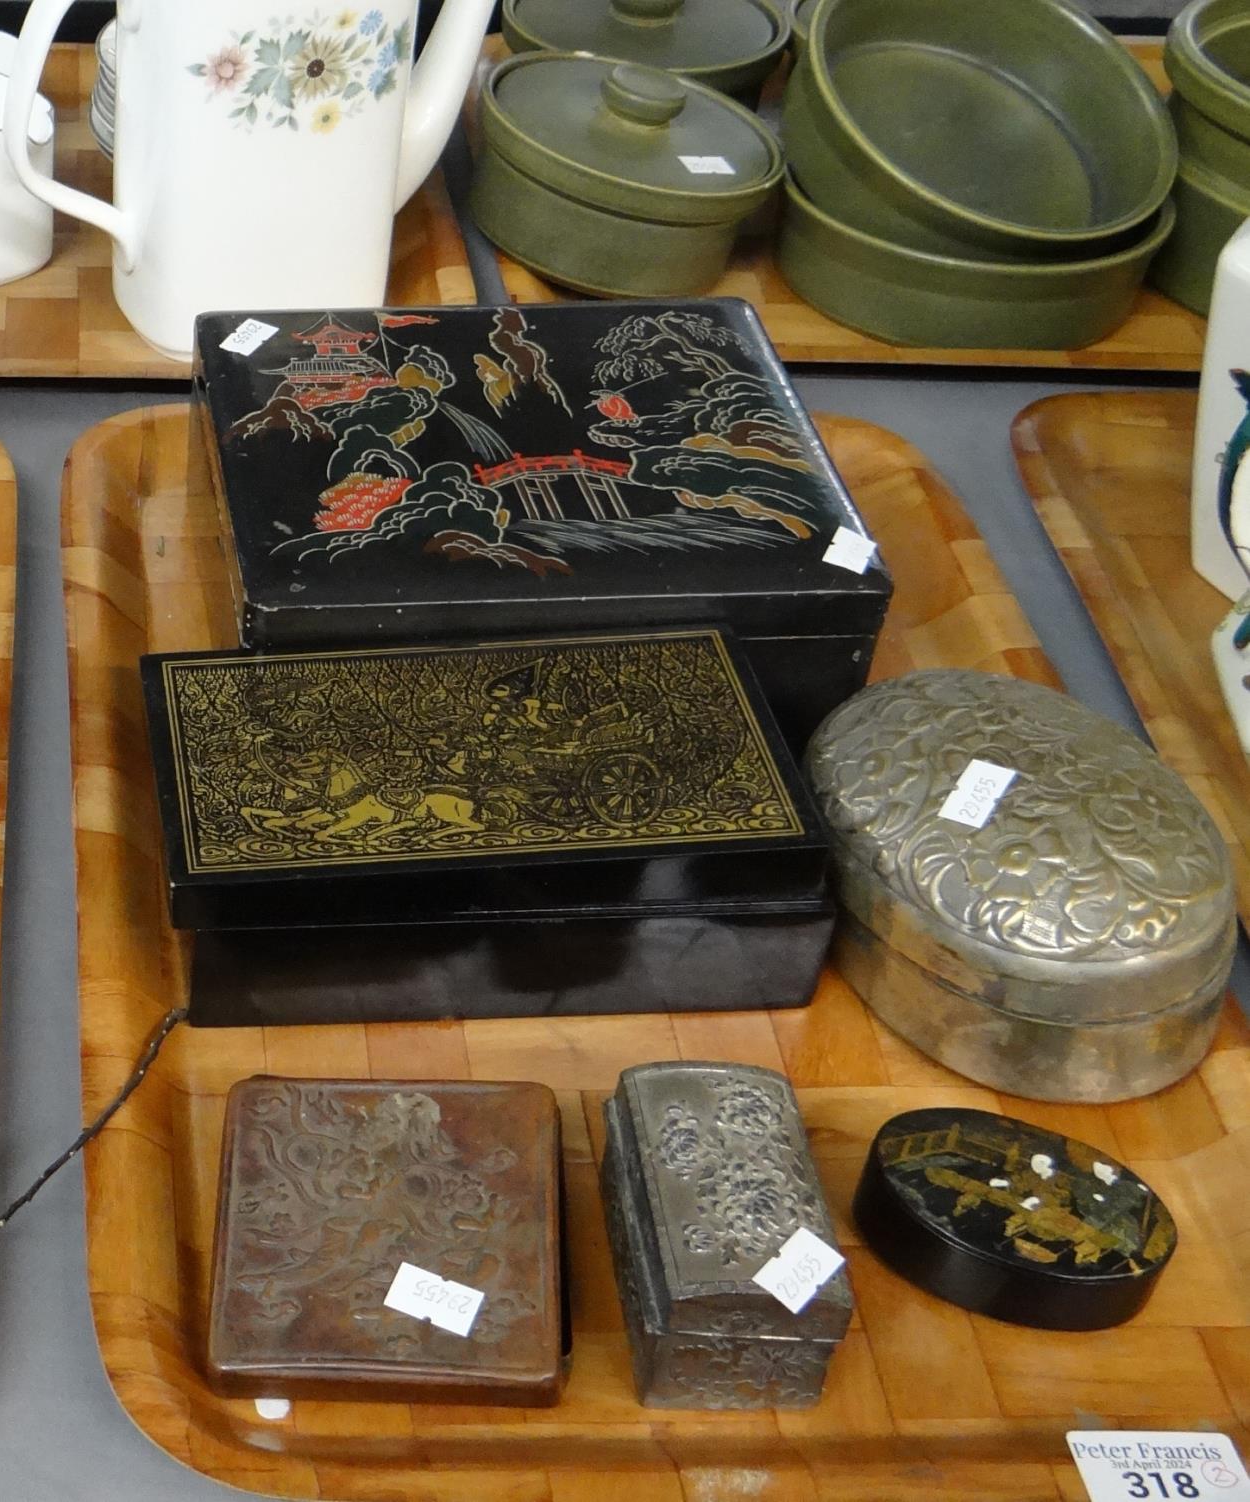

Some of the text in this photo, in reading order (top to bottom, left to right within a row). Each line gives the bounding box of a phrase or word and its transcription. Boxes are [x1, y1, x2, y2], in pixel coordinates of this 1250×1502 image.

[958, 776, 997, 820] 29455
[412, 1279, 474, 1314] 29455
[1072, 1442, 1222, 1461] Peter Francis
[1111, 1460, 1193, 1470] 3rd April 2024
[1122, 1471, 1200, 1499] 318
